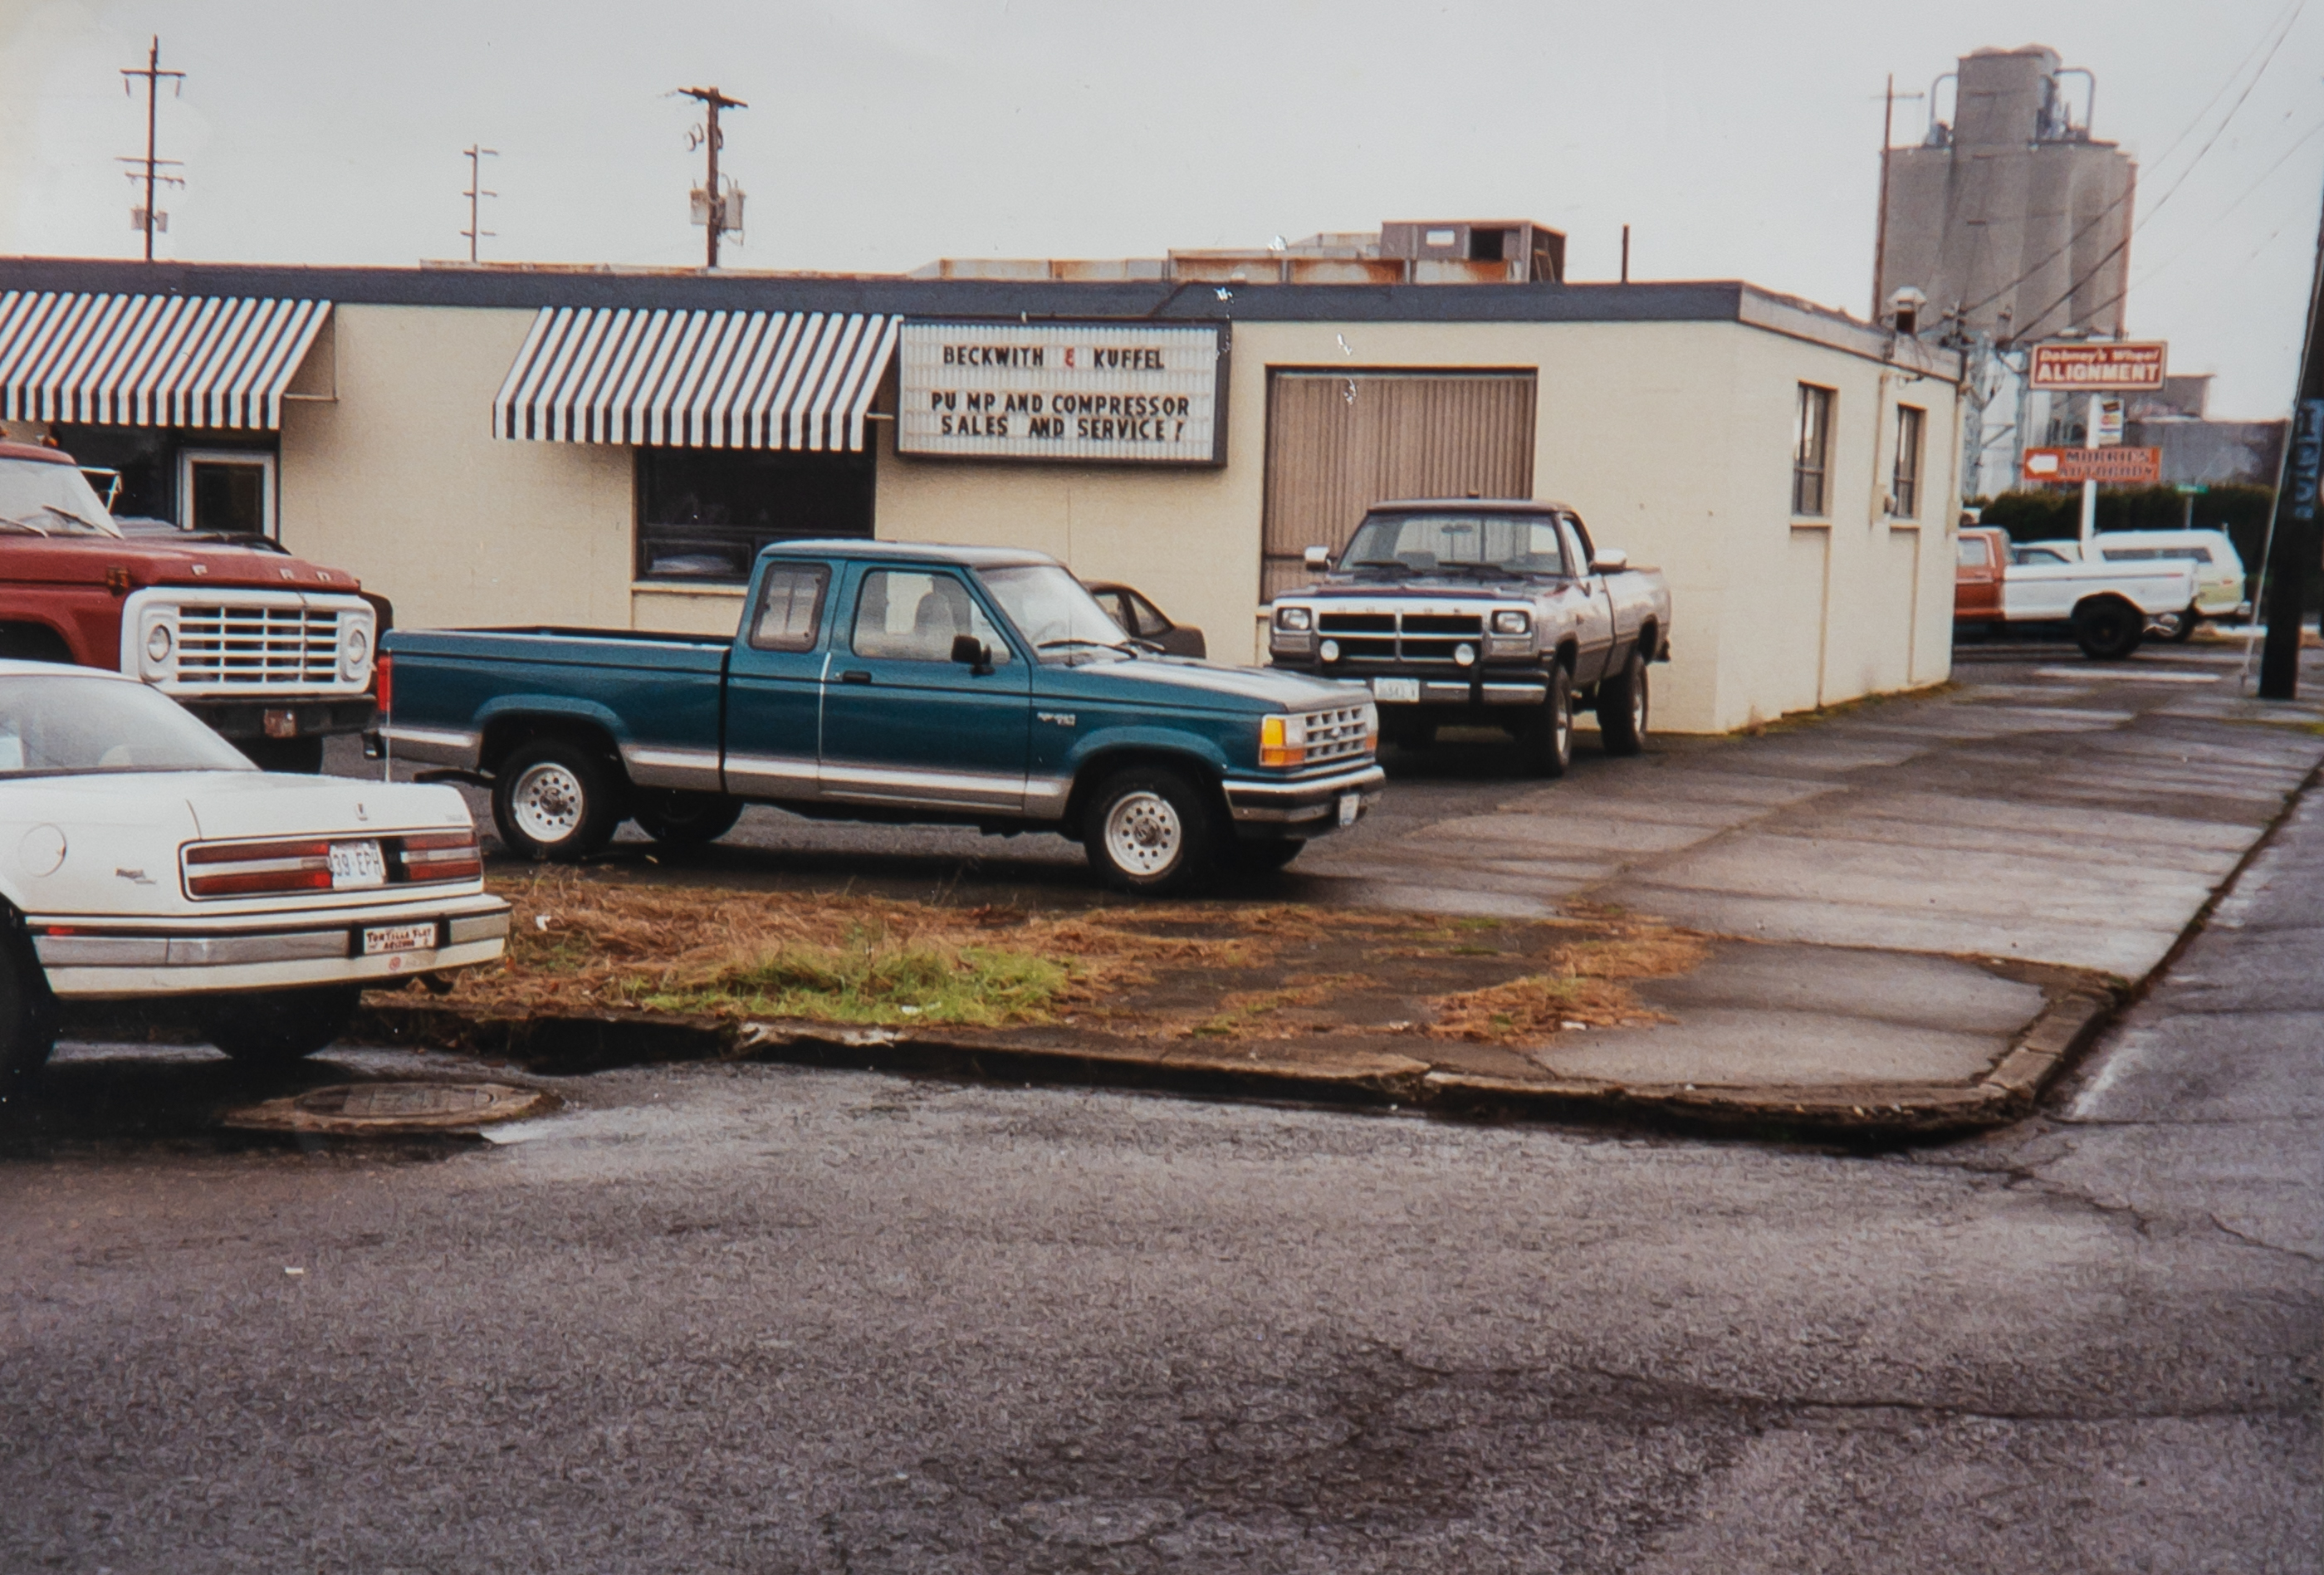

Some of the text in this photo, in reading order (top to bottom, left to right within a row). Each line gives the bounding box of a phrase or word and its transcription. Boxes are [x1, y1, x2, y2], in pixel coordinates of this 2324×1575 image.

[943, 346, 1045, 367] BECKWITH
[1094, 348, 1165, 369] KUFFEL
[2037, 363, 2159, 382] ALIGNMENT
[931, 391, 1190, 416] PUMP AND COMPRESSOR
[942, 415, 1008, 436] SALES
[1029, 418, 1065, 436] AND
